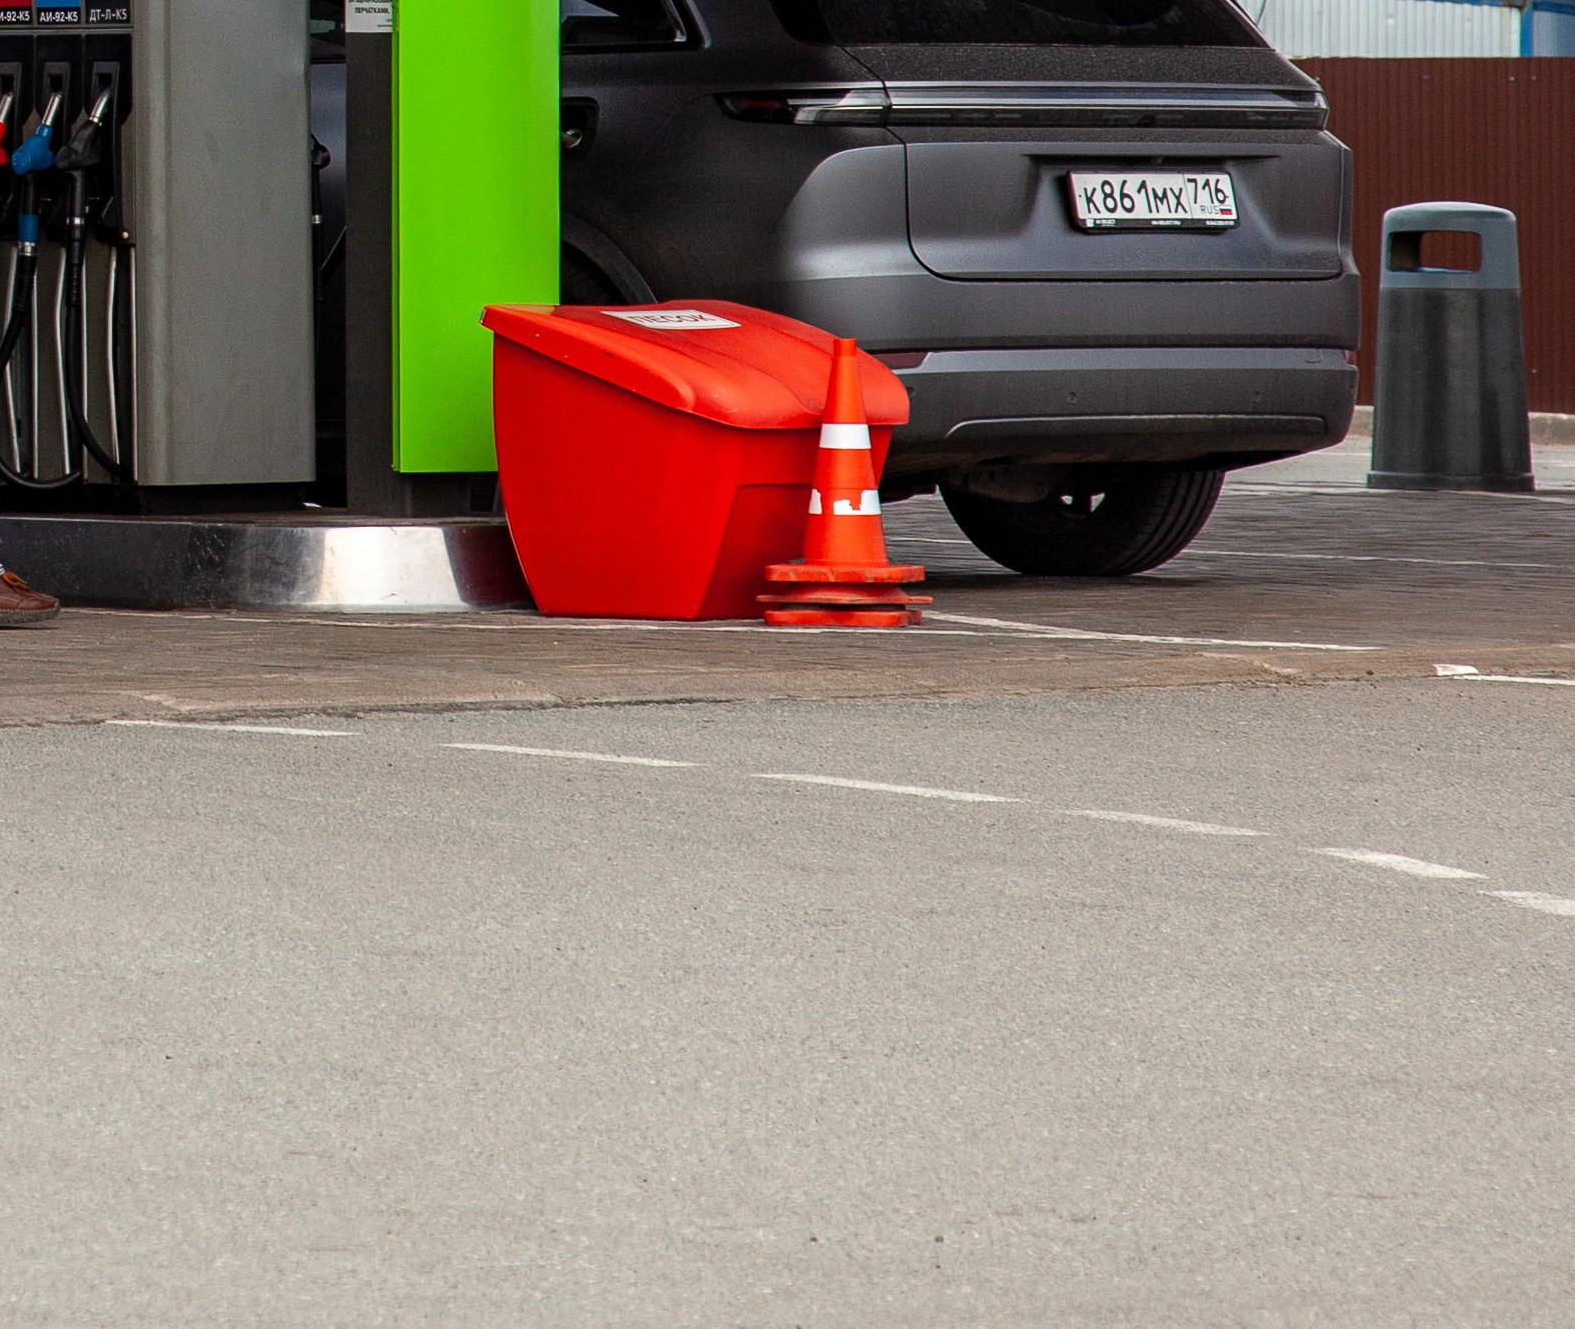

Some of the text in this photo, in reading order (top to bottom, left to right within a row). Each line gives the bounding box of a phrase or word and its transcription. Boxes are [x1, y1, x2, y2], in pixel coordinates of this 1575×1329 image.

[39, 11, 79, 22] АИ-92-К5
[89, 9, 127, 22] ДТ-Л-К5
[1083, 178, 1227, 214] К861МХ 716
[1200, 205, 1219, 215] RUS
